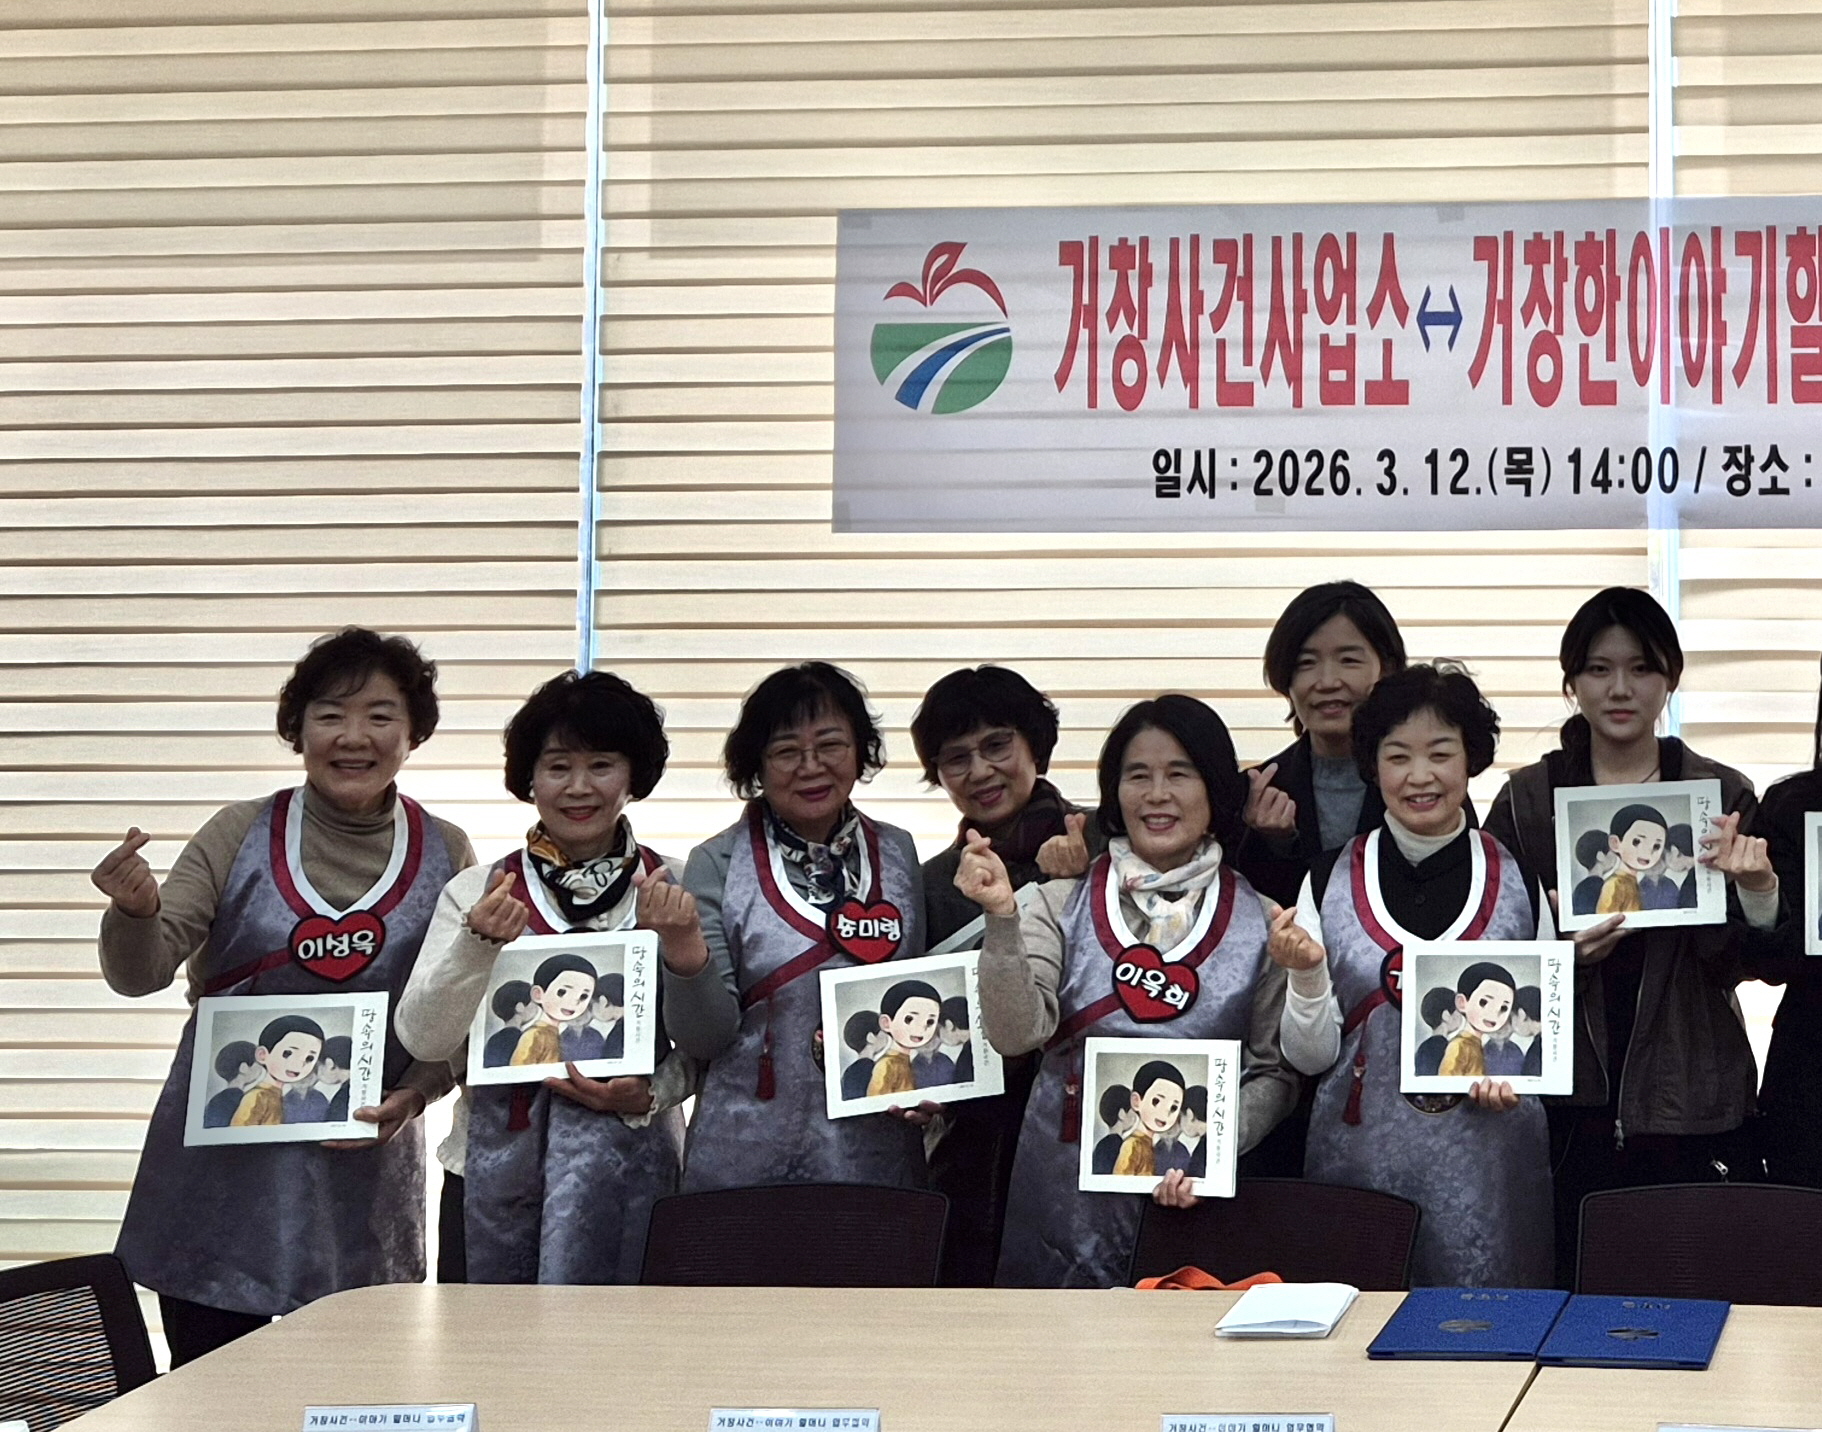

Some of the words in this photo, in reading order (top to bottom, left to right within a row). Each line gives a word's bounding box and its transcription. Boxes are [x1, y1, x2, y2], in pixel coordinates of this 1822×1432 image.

[1054, 232, 1410, 412] 거창사건사업소
[1152, 448, 1216, 500] 일시
[1253, 449, 1362, 497] 2026.
[1376, 448, 1409, 496] 3.
[1424, 446, 1551, 498] 12.(목)
[1568, 446, 1679, 495] 14:00
[1721, 444, 1790, 497] 장소
[298, 929, 376, 960] 이성옥
[1115, 962, 1190, 1010] 이옥희
